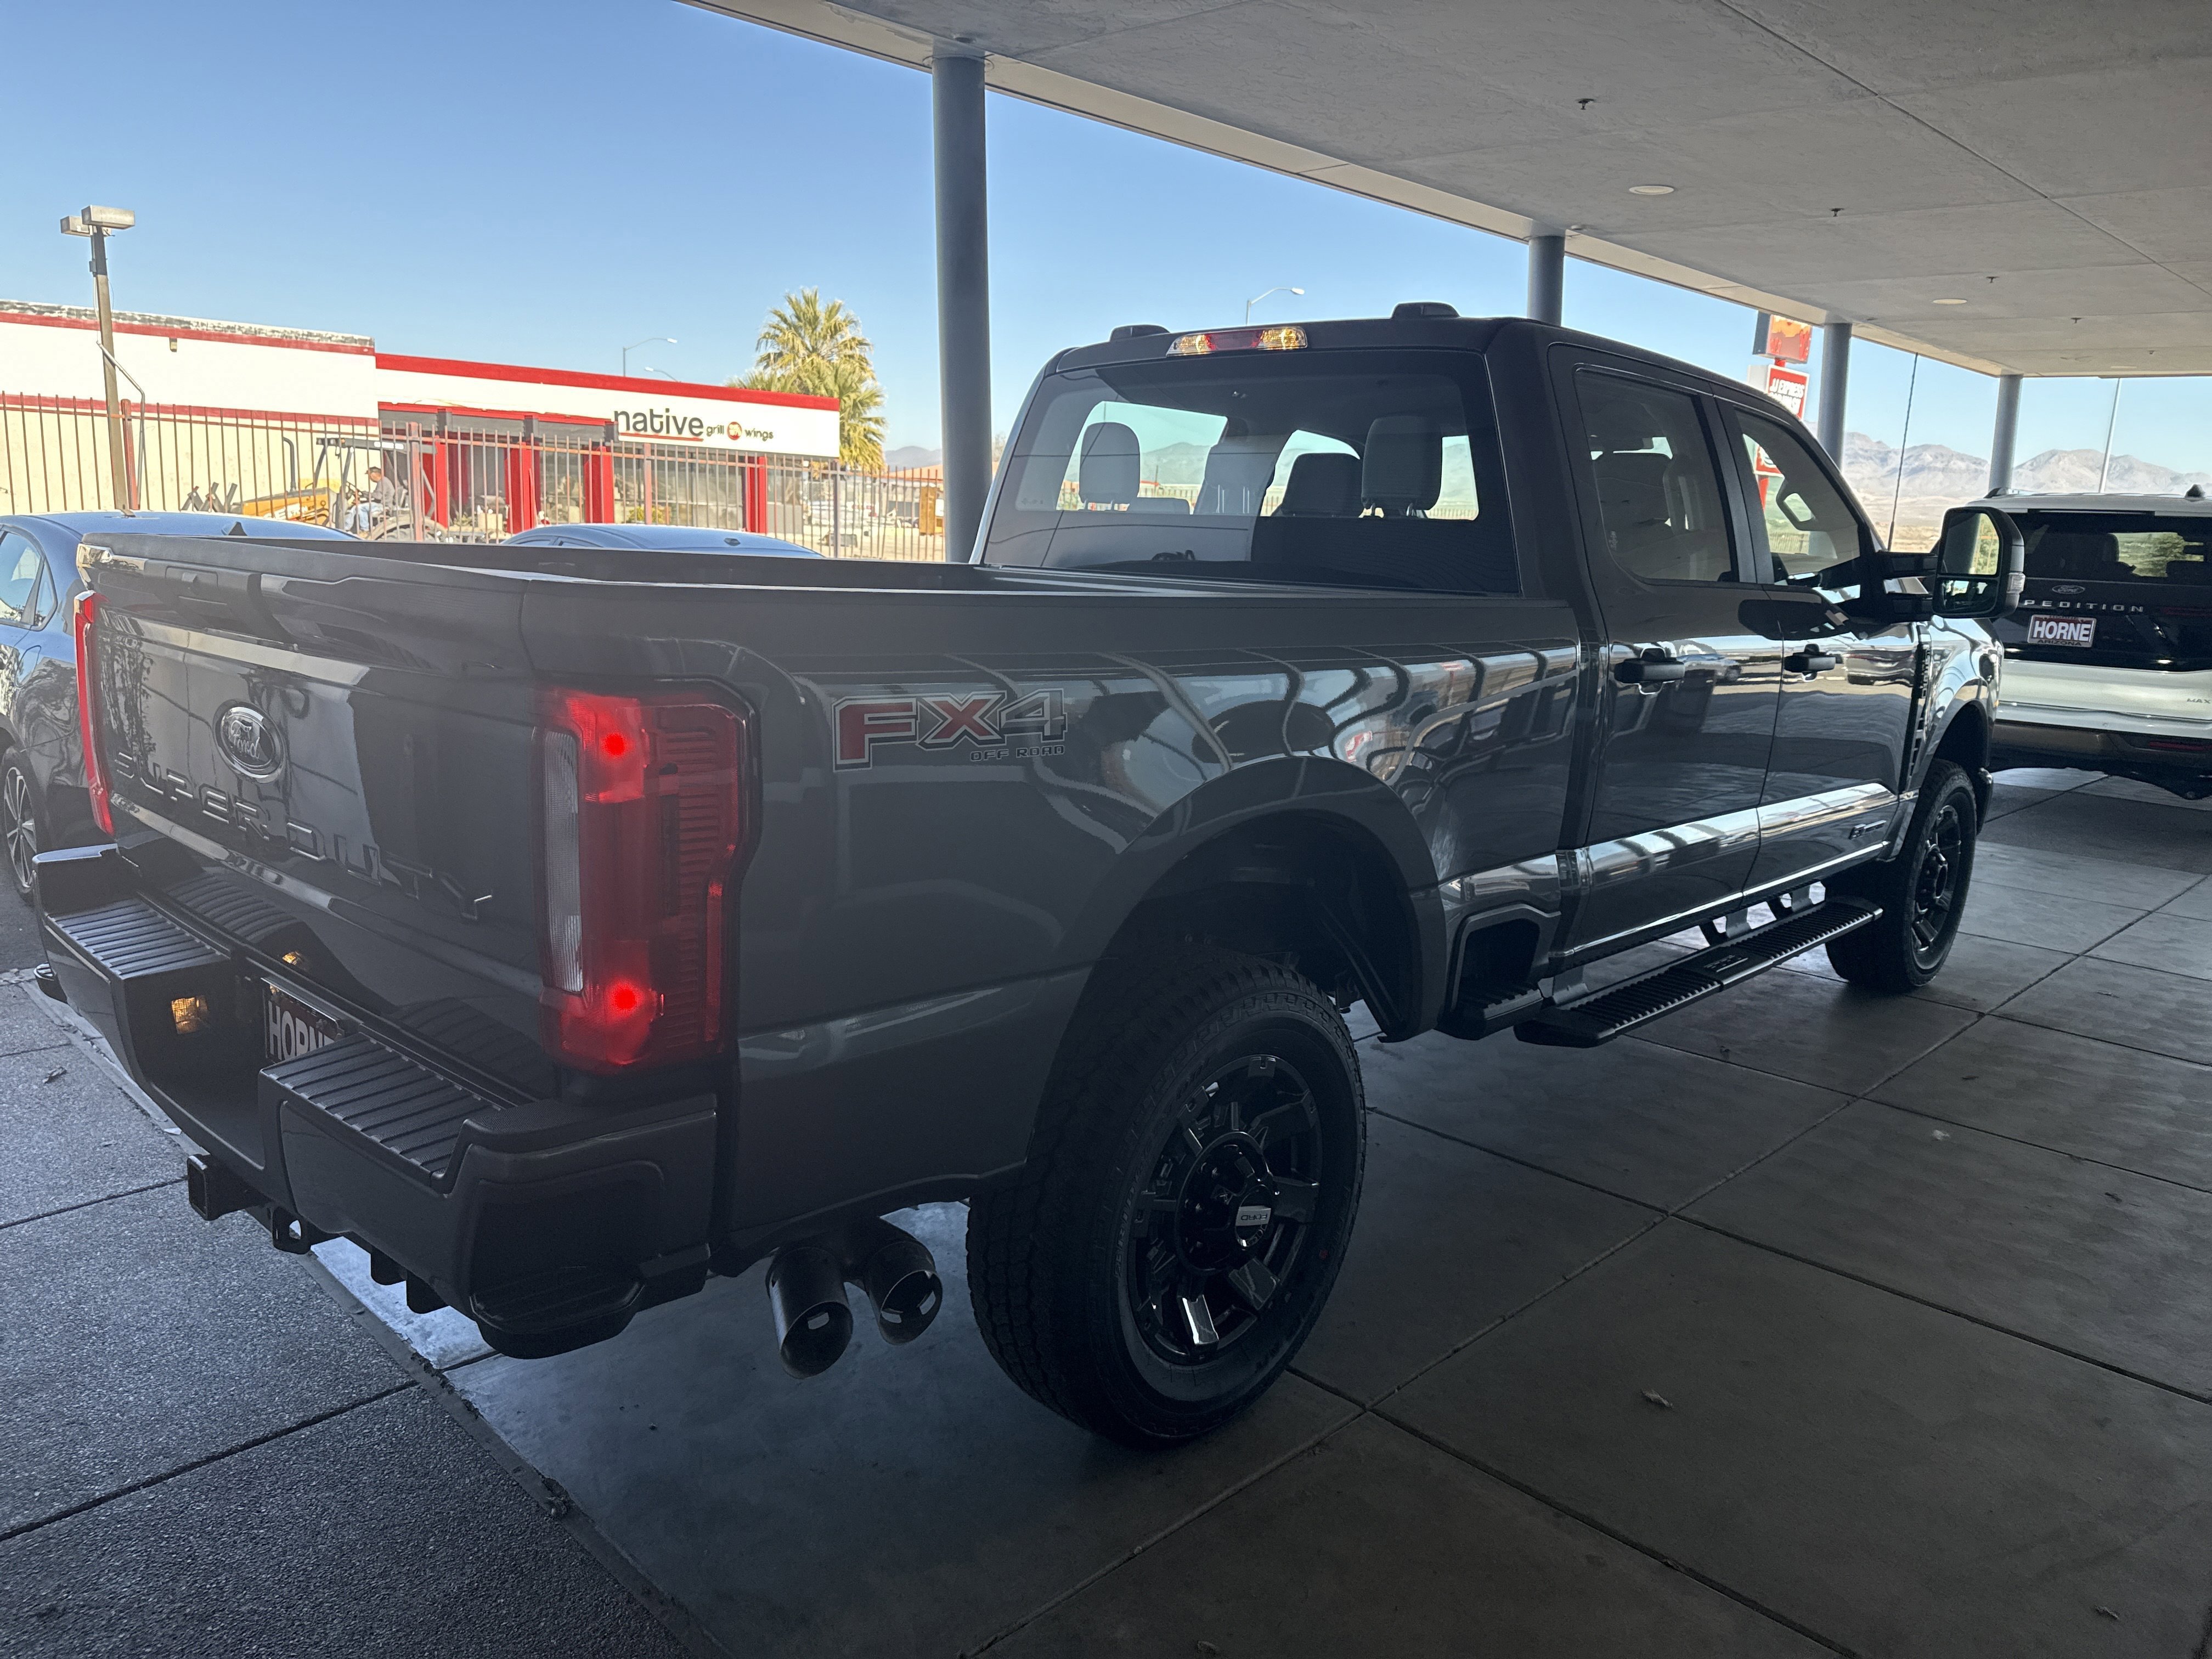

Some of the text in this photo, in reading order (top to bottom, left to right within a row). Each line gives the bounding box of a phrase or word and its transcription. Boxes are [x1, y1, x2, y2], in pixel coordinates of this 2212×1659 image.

[614, 408, 774, 441] native grill wings
[2023, 599, 2144, 612] PEDITION
[2033, 620, 2092, 642] HORNE
[832, 688, 1068, 772] FX4
[970, 744, 1065, 762] OFF ROAD
[114, 752, 493, 921] SUPER DUTY
[268, 1000, 336, 1060] HOR
